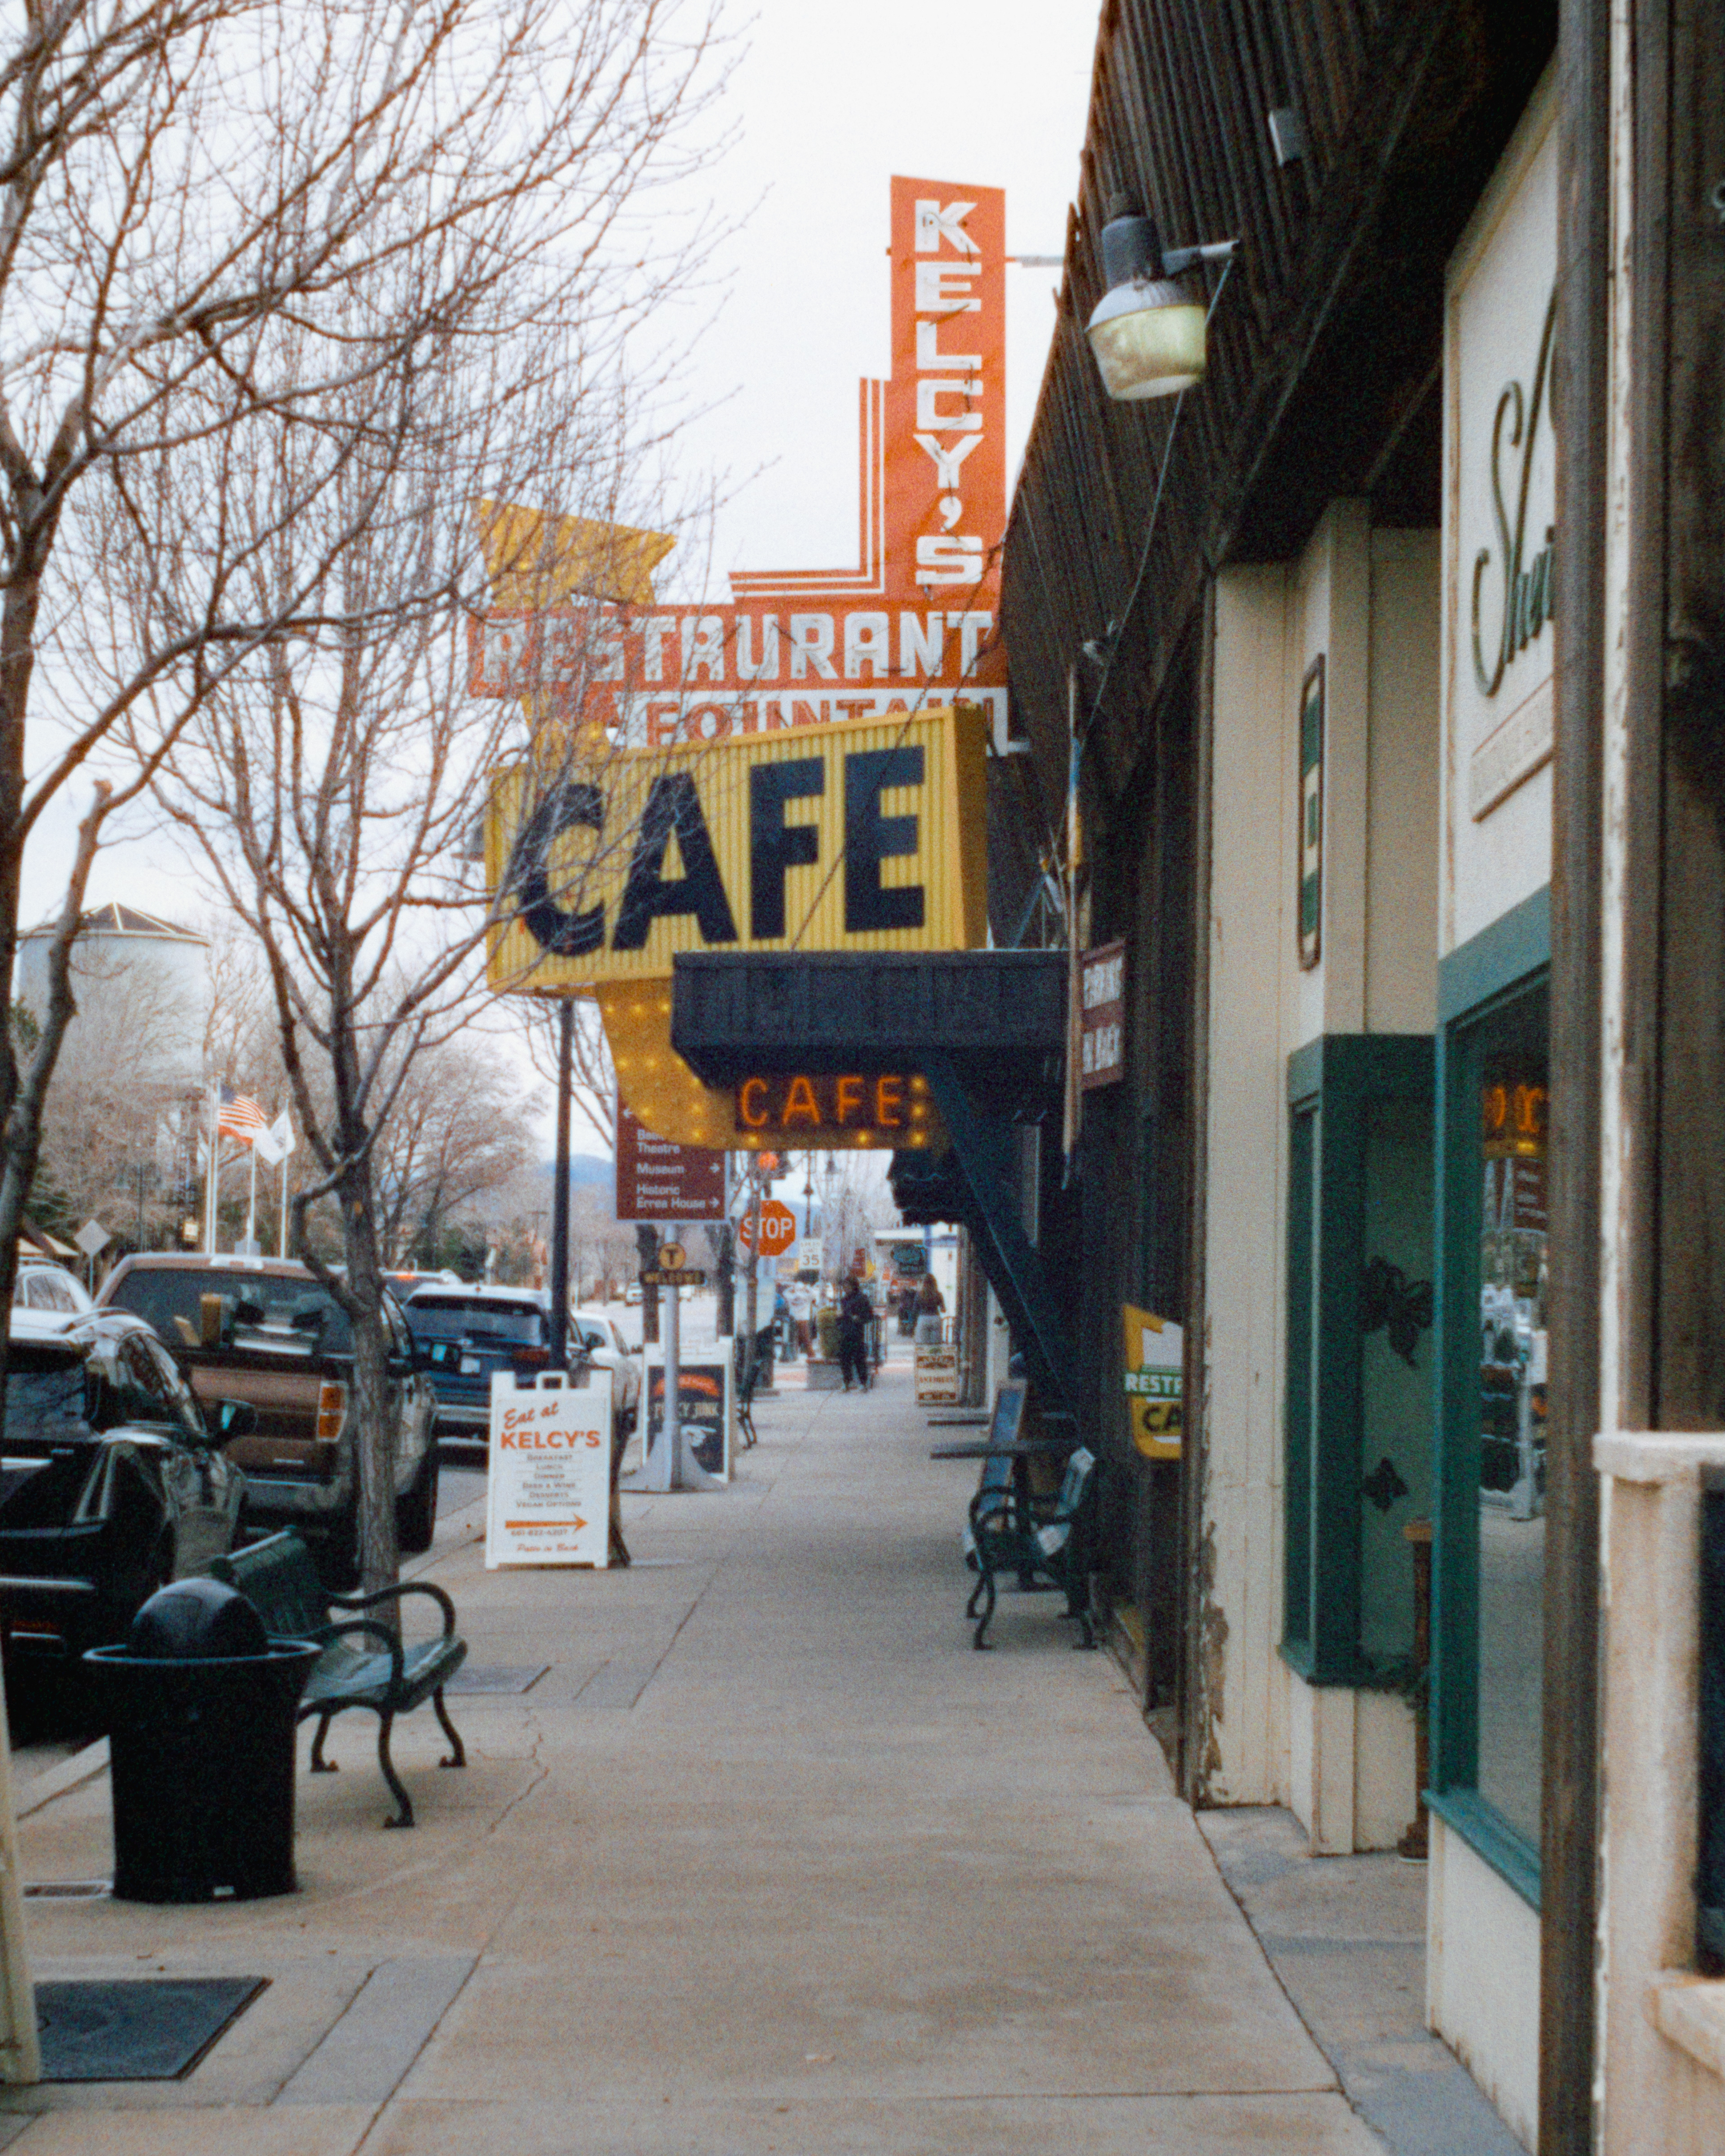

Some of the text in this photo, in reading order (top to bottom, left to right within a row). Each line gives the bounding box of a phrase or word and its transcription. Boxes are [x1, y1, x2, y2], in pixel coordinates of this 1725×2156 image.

[914, 199, 984, 585] KELCY'S
[483, 611, 993, 682] RESTAURANT
[523, 745, 925, 956] CAFE
[741, 1075, 901, 1126] CAFE
[637, 1141, 680, 1154] Theatre
[637, 1162, 685, 1175] Museum
[637, 1184, 680, 1195] Historic
[671, 1197, 706, 1208] House
[743, 1217, 792, 1239] STOP
[803, 1255, 819, 1266] 35
[504, 1401, 559, 1430] Eat at
[500, 1430, 601, 1449] KELCY'S
